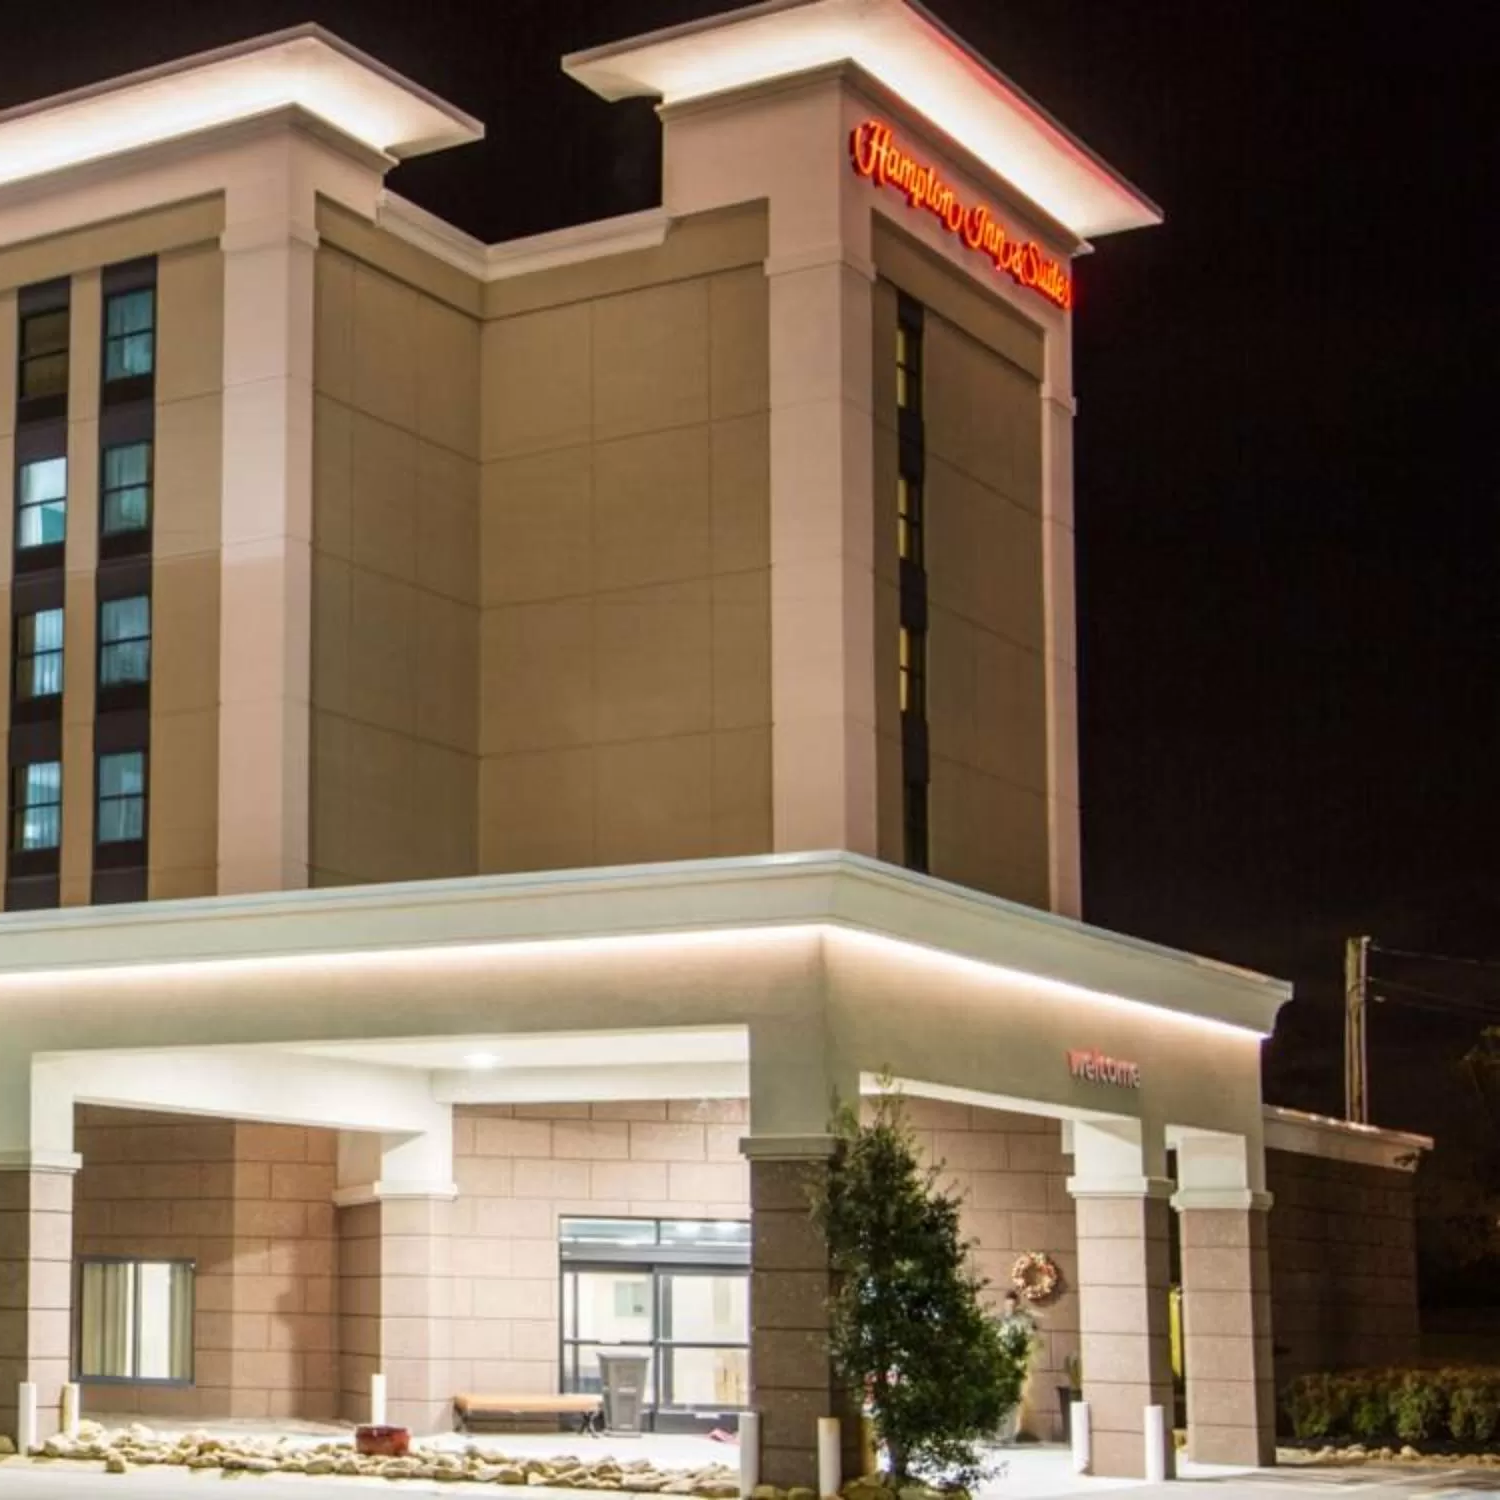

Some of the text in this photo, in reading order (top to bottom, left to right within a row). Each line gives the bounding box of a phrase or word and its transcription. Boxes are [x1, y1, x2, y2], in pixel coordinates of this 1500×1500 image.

[850, 118, 964, 235] Hampton
[958, 204, 1014, 270] Inn
[1019, 241, 1072, 310] Suites
